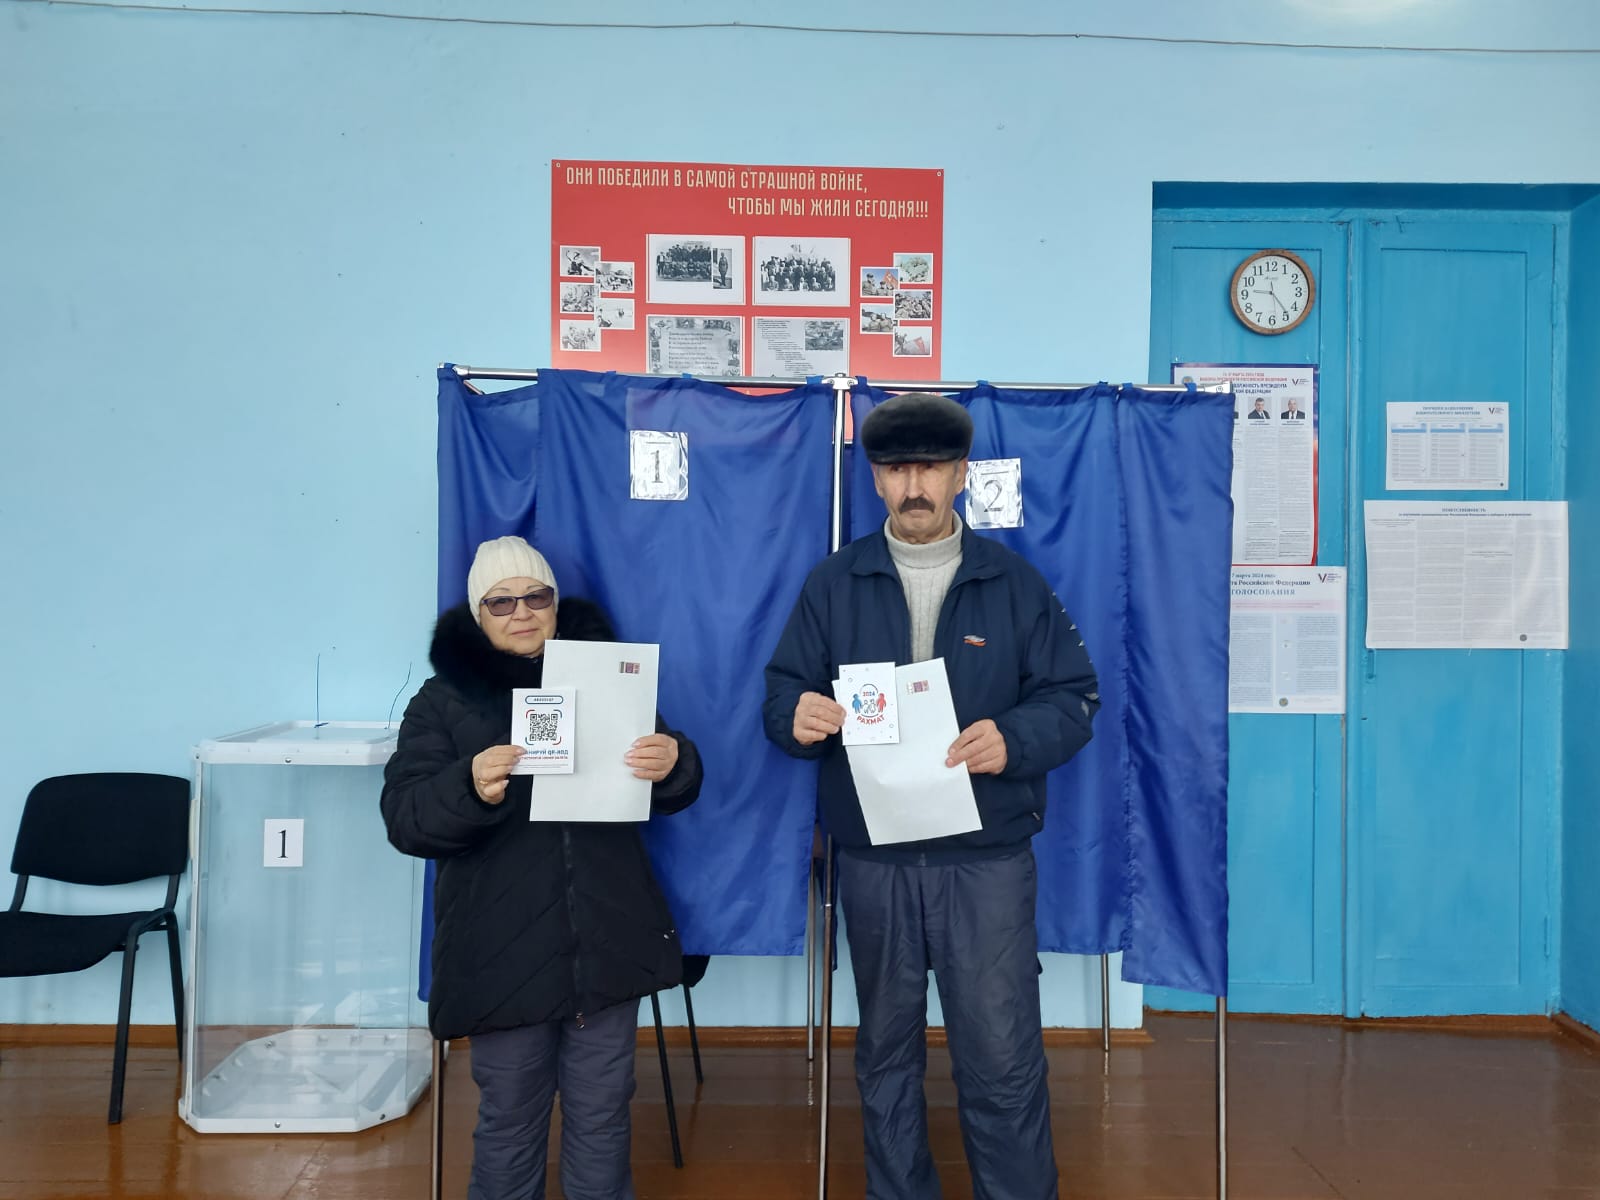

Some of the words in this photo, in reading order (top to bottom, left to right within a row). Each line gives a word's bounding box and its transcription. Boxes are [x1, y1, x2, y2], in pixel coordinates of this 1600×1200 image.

[566, 167, 593, 185] ОНИ
[598, 167, 669, 188] ПОБЕДИЛИ
[674, 169, 682, 187] В
[686, 168, 736, 189] САМОЙ
[740, 169, 816, 190] СТРАШНОЙ
[820, 170, 868, 193] ВОЙНЕ,
[728, 197, 775, 216] ЧТОБЫ
[780, 198, 805, 216] МЫ
[810, 198, 850, 217] ЖИЛИ
[855, 199, 929, 219] СЕГОДНЯ!!!
[1253, 265, 1264, 276] 11
[1265, 260, 1278, 272] 12
[1282, 264, 1288, 275] 1
[1243, 276, 1255, 287] 10
[1291, 273, 1299, 284] 2
[1241, 289, 1249, 300] 9
[1295, 287, 1302, 298] 3
[1245, 302, 1253, 313] 8
[1291, 301, 1298, 311] 4
[1256, 312, 1262, 323] 7
[1268, 315, 1276, 326] 6
[1282, 311, 1290, 321] 5
[650, 449, 664, 483] 1
[983, 479, 1004, 513] 2
[856, 714, 885, 725] РАХМАТ
[277, 829, 288, 859] 1
